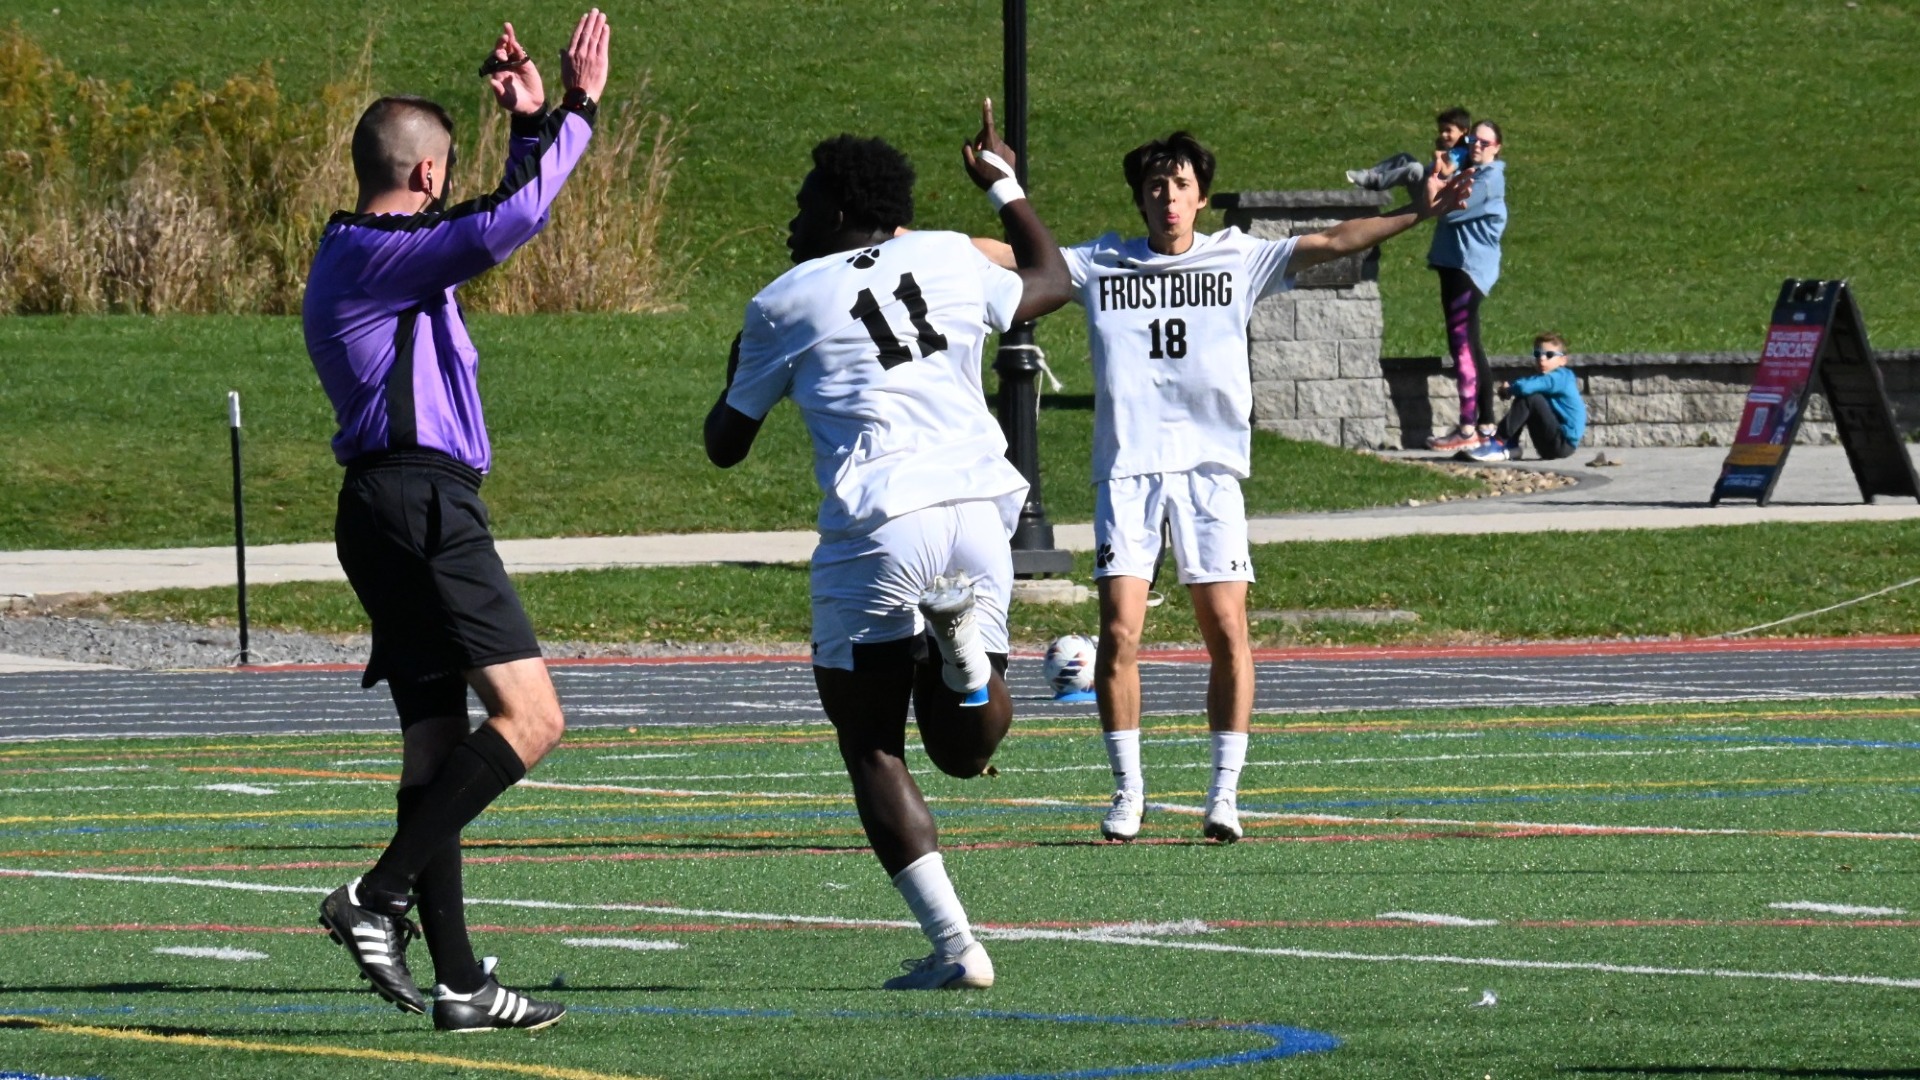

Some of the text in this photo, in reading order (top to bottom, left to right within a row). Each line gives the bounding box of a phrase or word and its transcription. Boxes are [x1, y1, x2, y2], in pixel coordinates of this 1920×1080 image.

[1098, 272, 1233, 311] FROSTBURG
[849, 272, 948, 371] 11
[1148, 318, 1187, 359] 18
